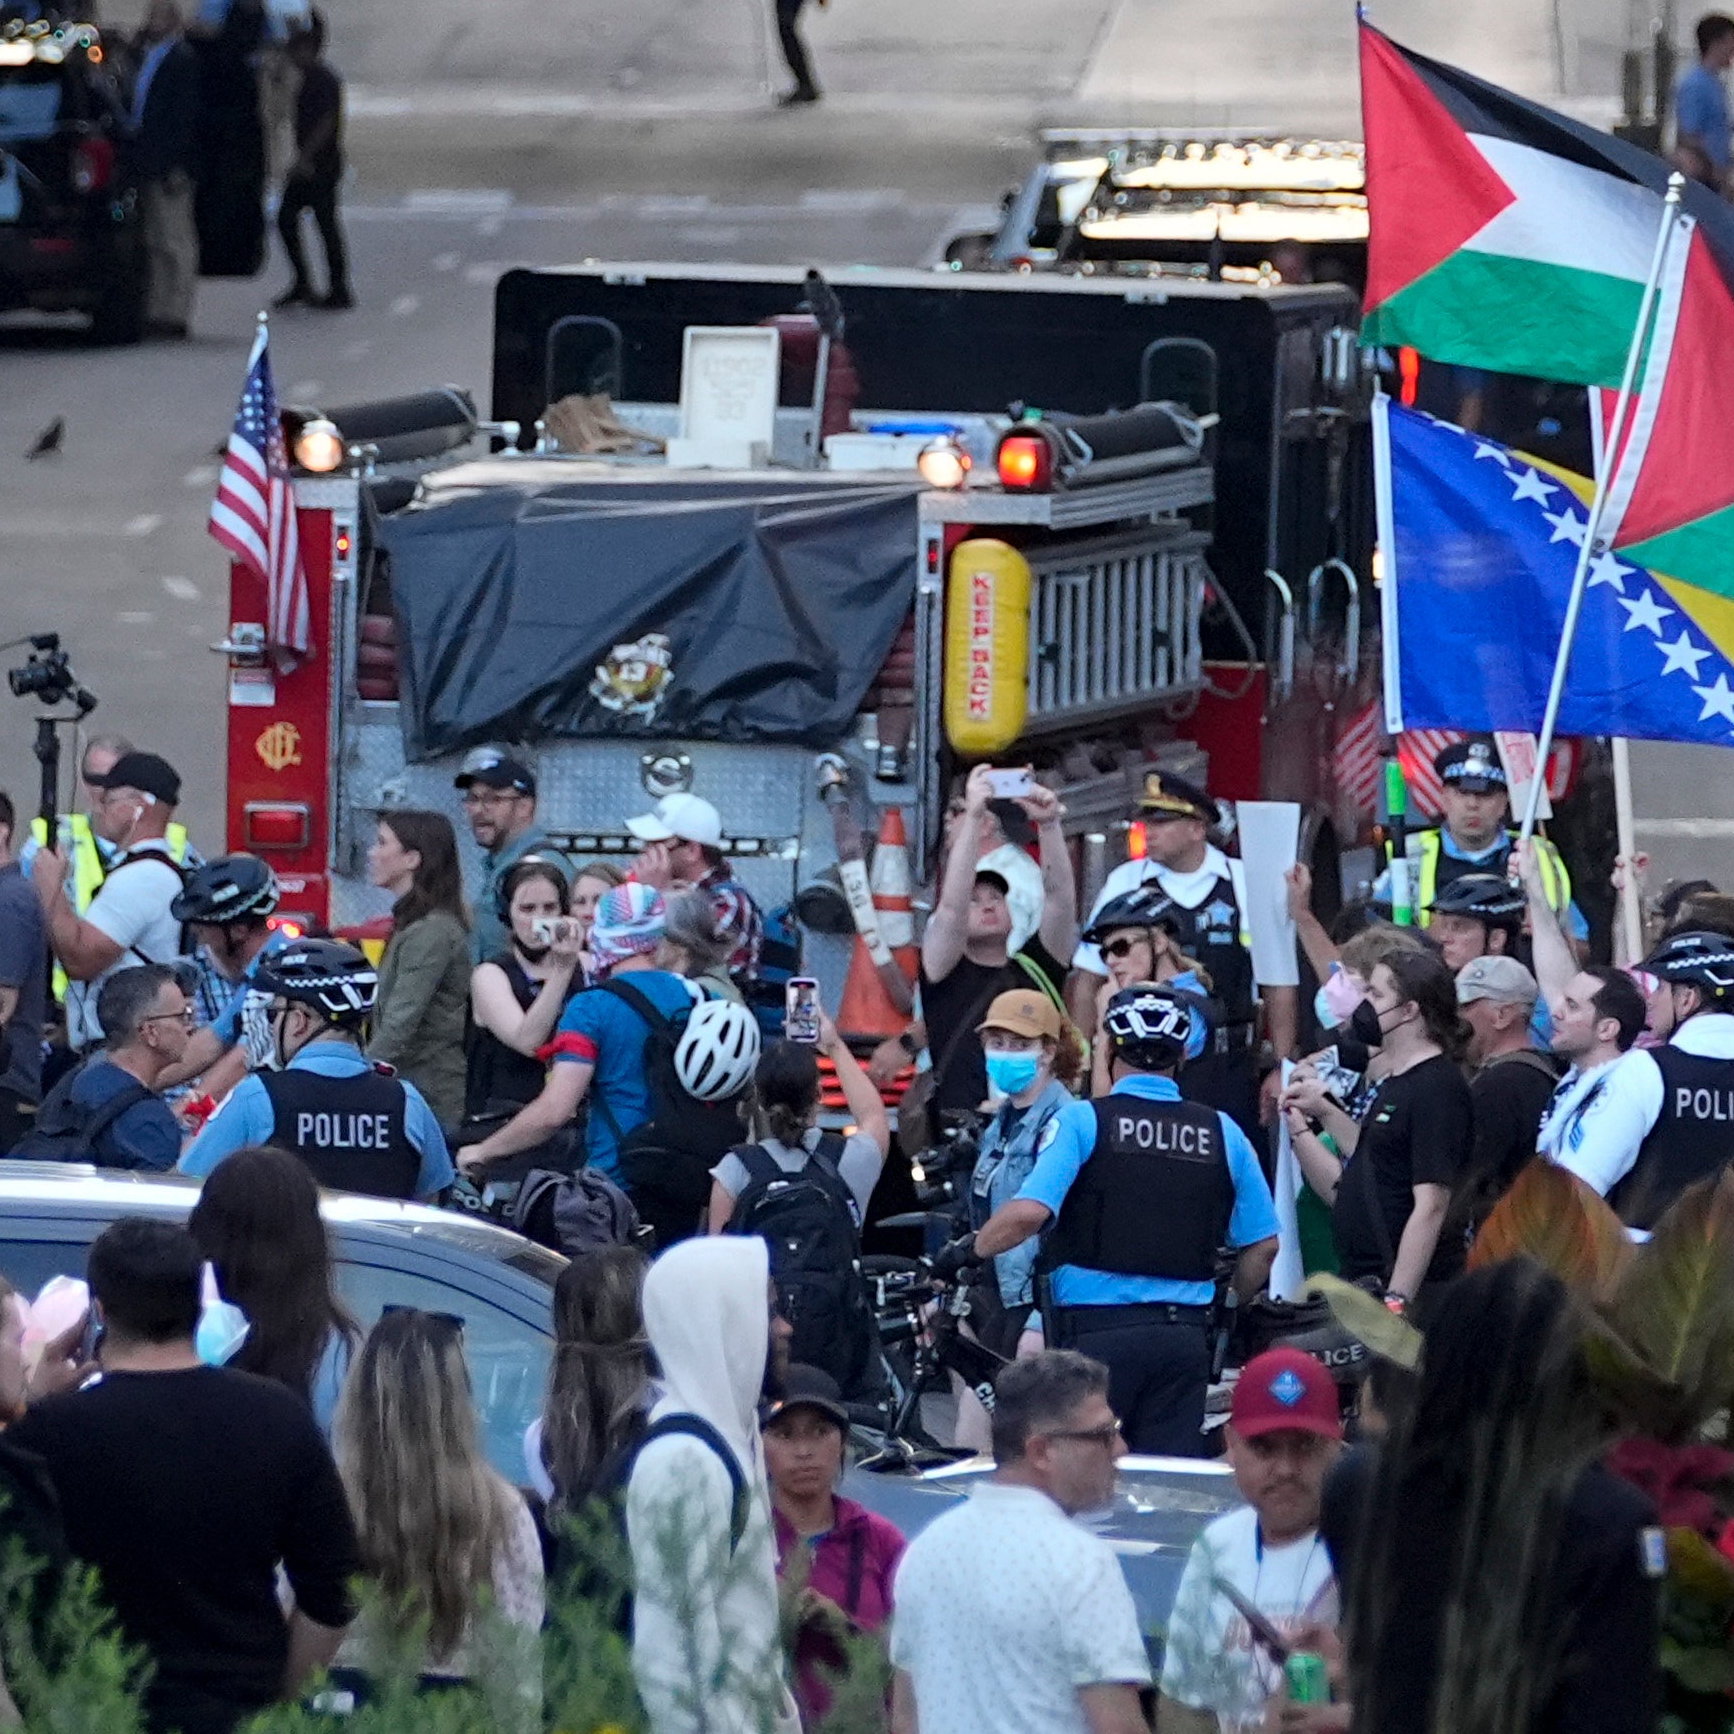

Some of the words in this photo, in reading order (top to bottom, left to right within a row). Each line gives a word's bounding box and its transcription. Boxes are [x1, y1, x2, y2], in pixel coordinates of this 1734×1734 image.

[971, 575, 991, 640] KEEP
[969, 649, 991, 715] BACK
[296, 1112, 391, 1149] POLICE
[1117, 1117, 1212, 1156] POLICE
